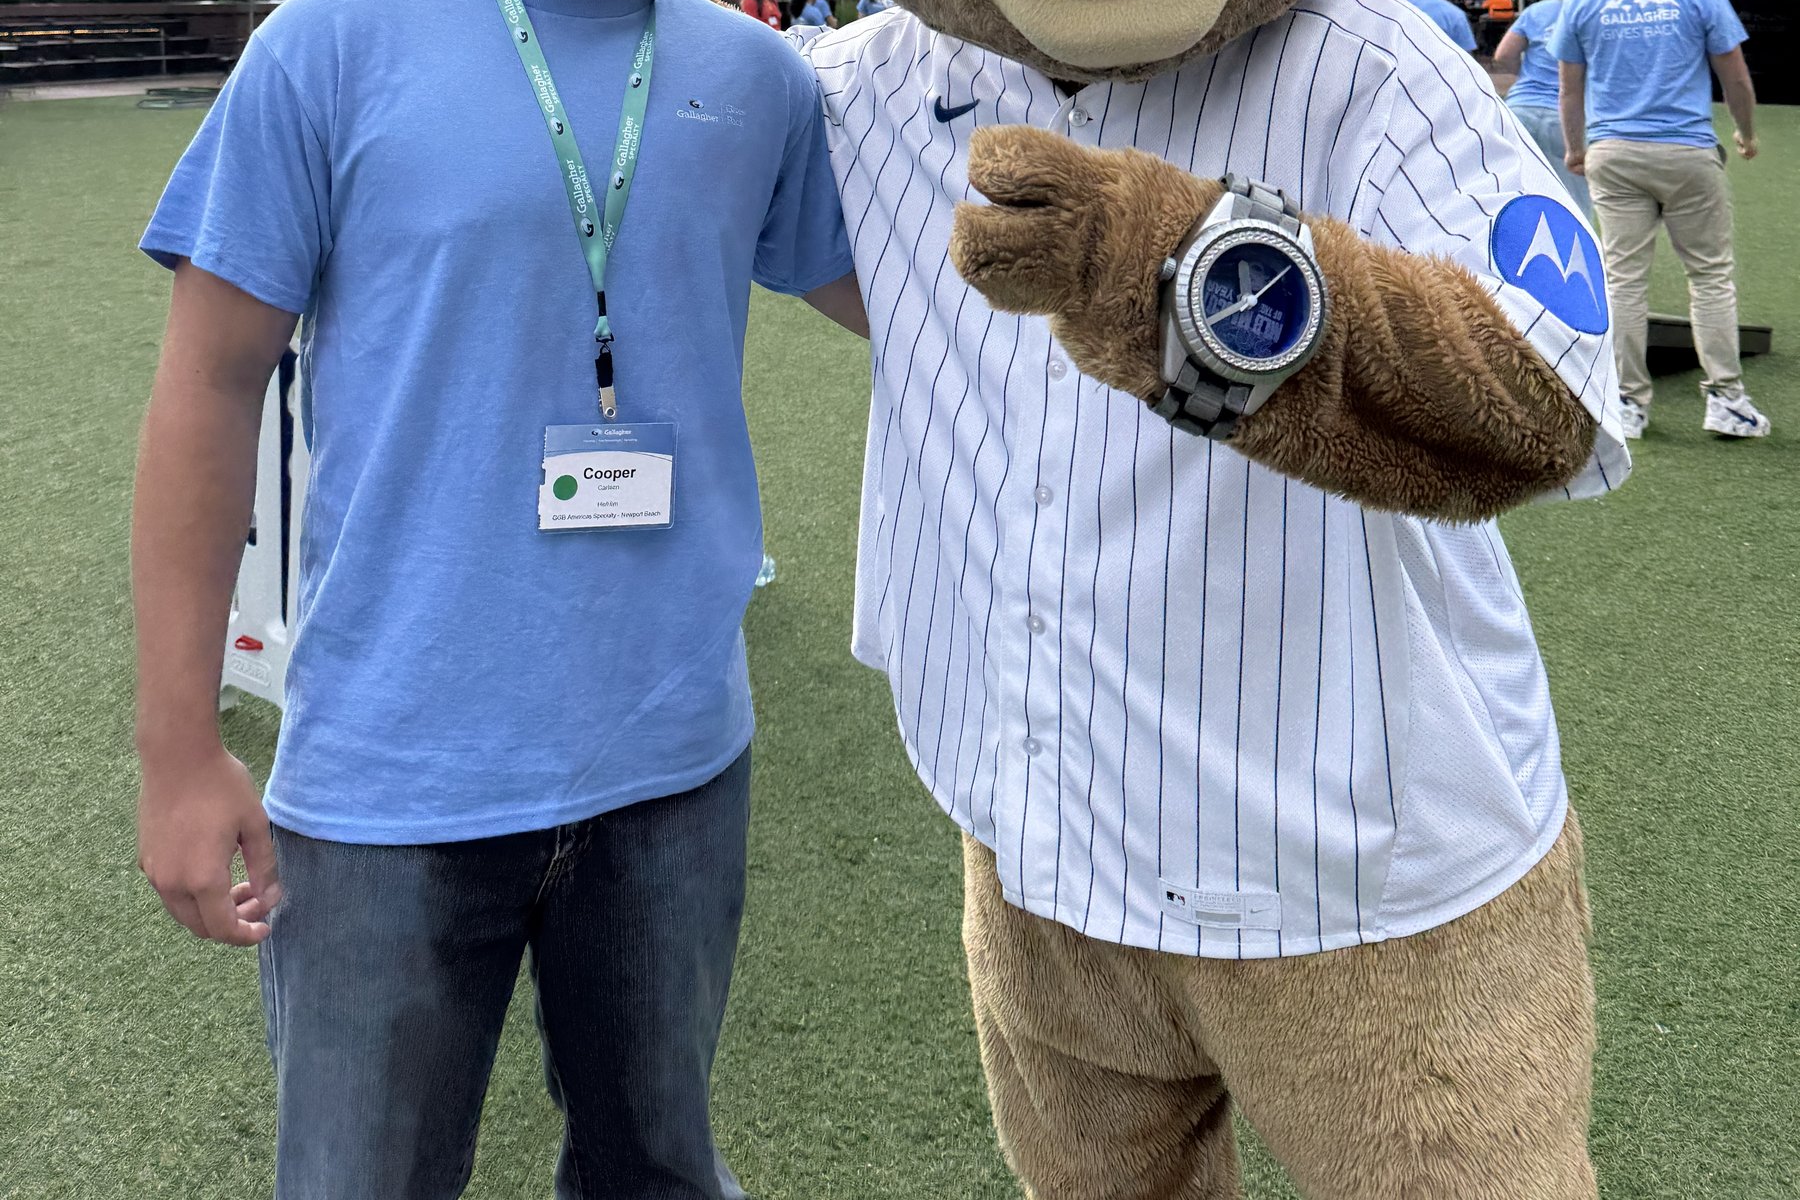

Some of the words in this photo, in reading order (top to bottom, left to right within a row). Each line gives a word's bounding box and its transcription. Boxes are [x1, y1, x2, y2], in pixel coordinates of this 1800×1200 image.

[1599, 8, 1681, 26] GALLAGHER
[1602, 26, 1640, 41] GIVES
[1643, 24, 1681, 38] BACK
[530, 64, 555, 113] Gallagher
[542, 70, 559, 104] SPECIALTY
[676, 109, 719, 123] Gallagher
[617, 115, 634, 167] Gallagher
[628, 124, 641, 160] SPECIALTY
[566, 159, 587, 214] Gallagher
[577, 165, 594, 203] SPECIALTY
[583, 467, 637, 482] Cooper
[593, 512, 617, 520] Specialty
[621, 511, 644, 519] Newport
